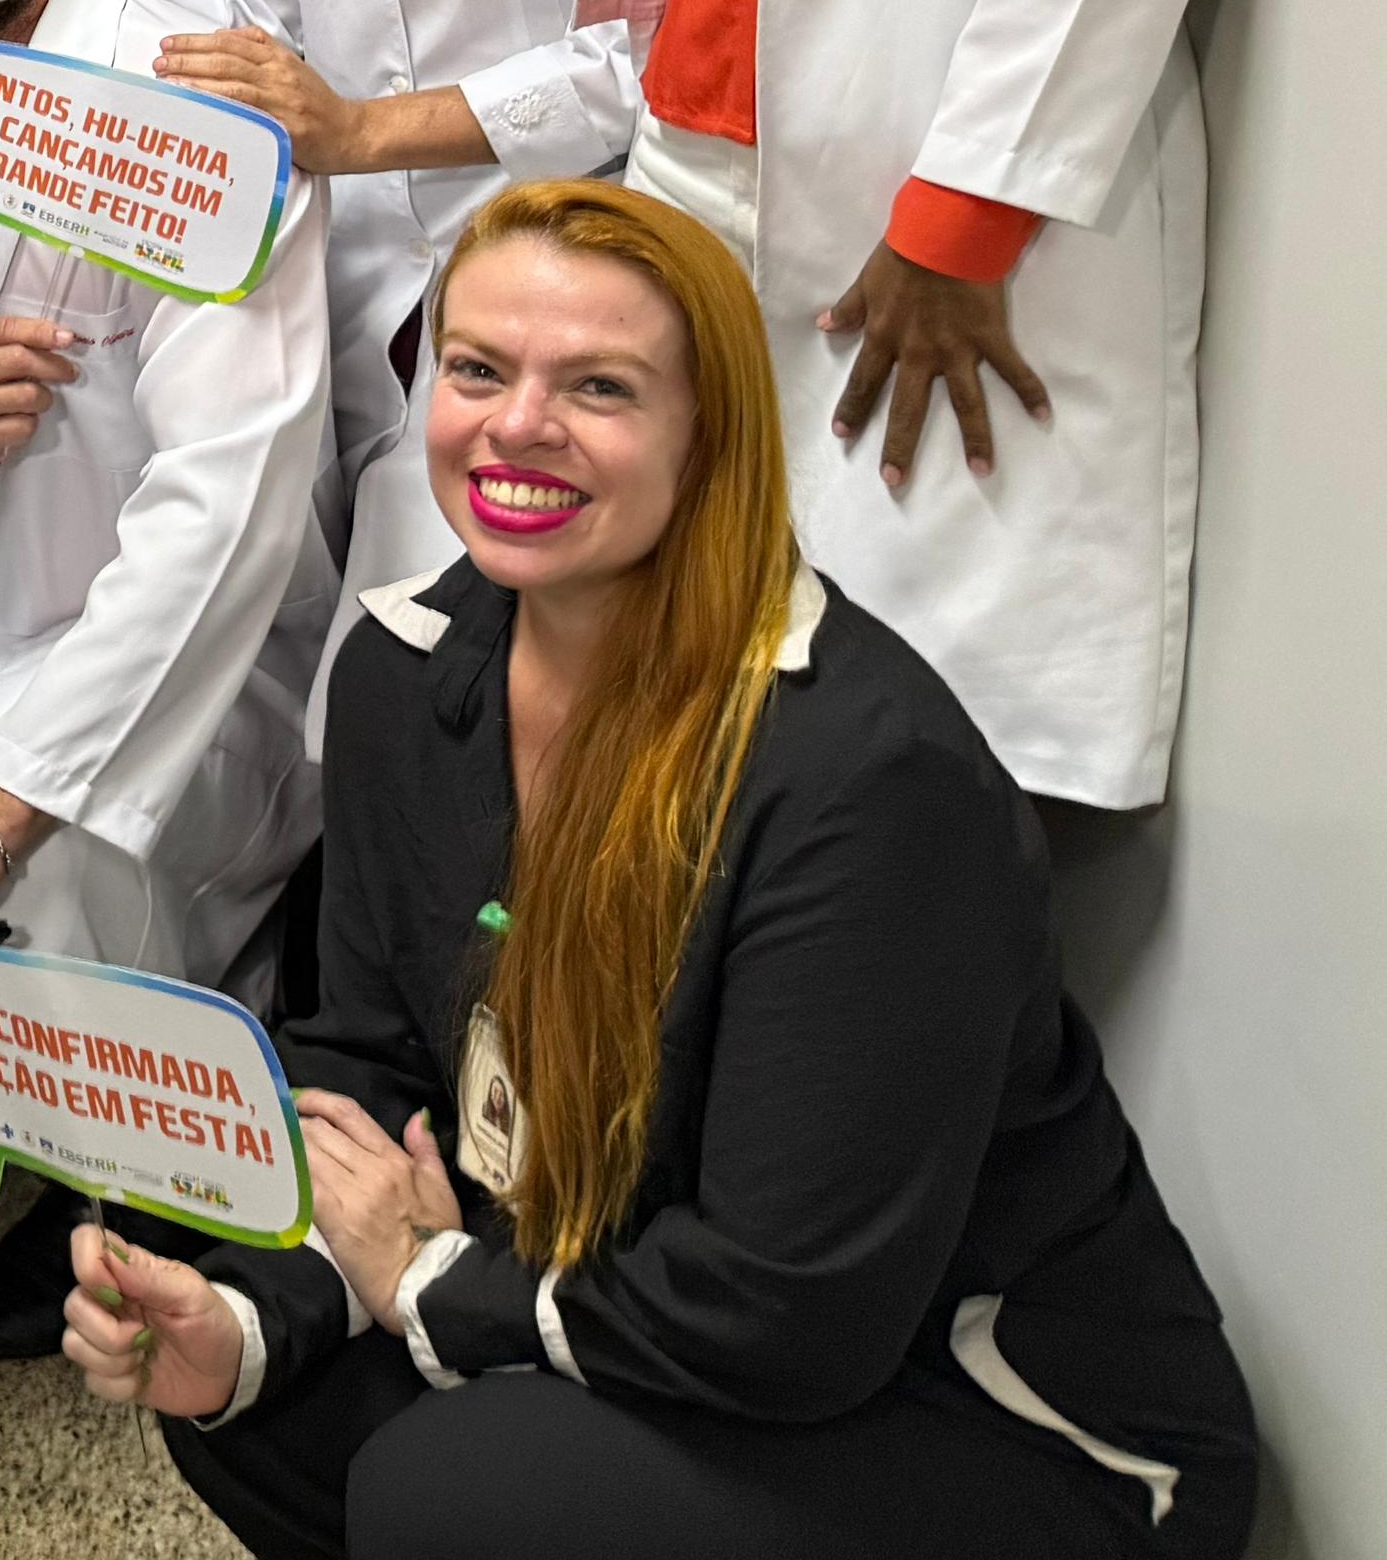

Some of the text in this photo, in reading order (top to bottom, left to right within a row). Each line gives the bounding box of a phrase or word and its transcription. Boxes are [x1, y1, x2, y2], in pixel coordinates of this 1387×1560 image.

[82, 107, 236, 187] HU-UFMA,
[39, 209, 90, 236] EBSERH
[88, 190, 188, 244] FEITO!
[171, 176, 224, 217] UM
[63, 1079, 127, 1125] EM
[128, 1094, 275, 1167] FESTA!
